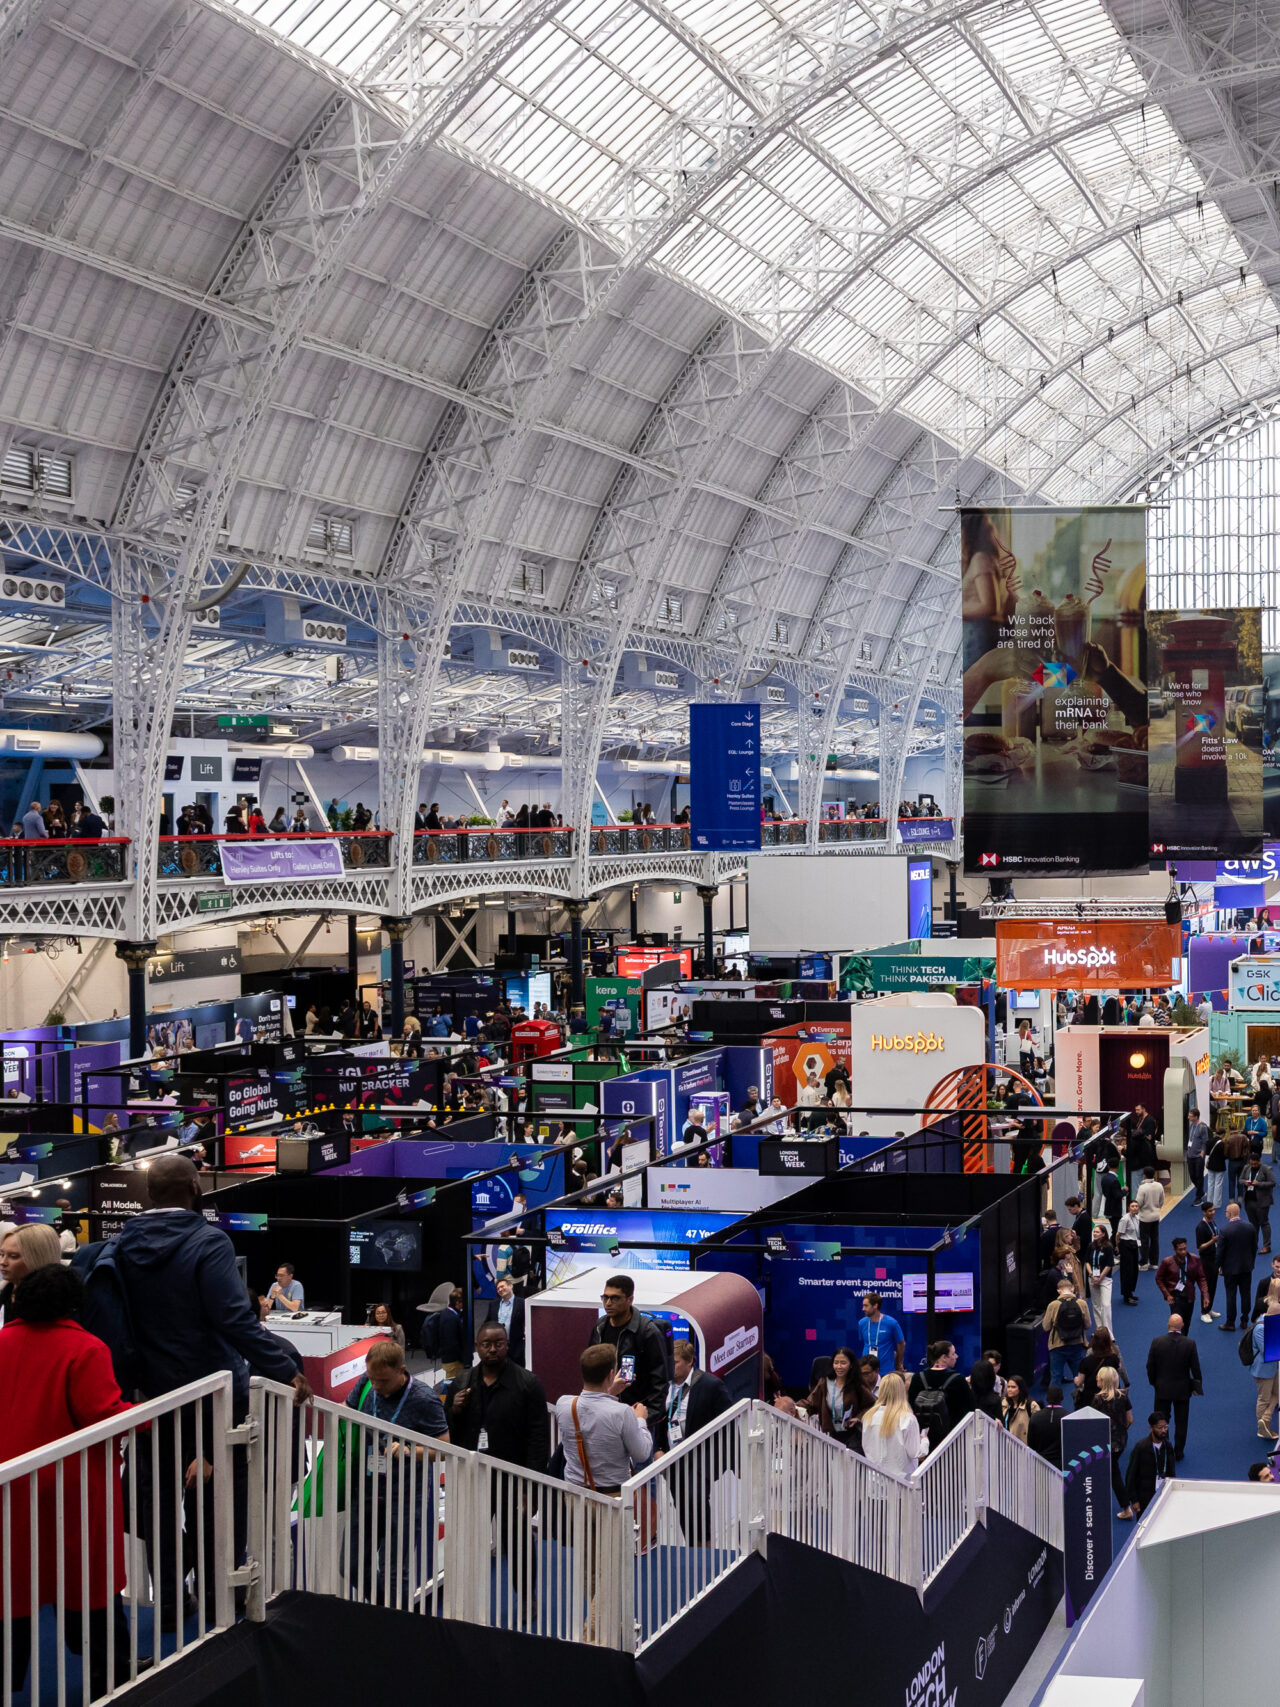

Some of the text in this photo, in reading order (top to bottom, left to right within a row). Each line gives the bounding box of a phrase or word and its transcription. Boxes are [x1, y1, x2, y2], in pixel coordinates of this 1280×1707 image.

[1008, 614, 1054, 625] We back
[998, 627, 1054, 637] those who
[1016, 638, 1040, 648] tired
[1044, 638, 1054, 648] of
[1055, 696, 1109, 708] explaining
[1055, 708, 1107, 718] mRNA to
[1055, 720, 1108, 730] their bank
[200, 764, 214, 774] Lift
[270, 851, 294, 859] Lifts to:
[1023, 855, 1054, 863] Innovation
[1055, 855, 1080, 865] Banking
[1224, 852, 1276, 870] aws
[1044, 946, 1117, 968] HubSpot
[170, 962, 185, 973] Lift
[891, 966, 946, 974] THINK TECH
[1247, 970, 1270, 978] GSK
[871, 1032, 944, 1054] HubSpot
[339, 1078, 410, 1092] NUCRACKER
[229, 1082, 271, 1102] Go Global
[230, 1098, 278, 1118] Going Nuts
[321, 1148, 333, 1156] TECH
[324, 1153, 337, 1161] WEEK
[113, 1201, 143, 1209] Models.
[686, 1230, 696, 1238] 47
[798, 1278, 902, 1289] Smarter event spending
[1084, 1476, 1094, 1494] win
[1085, 1537, 1094, 1580] Discover
[906, 1640, 945, 1707] LONDON
